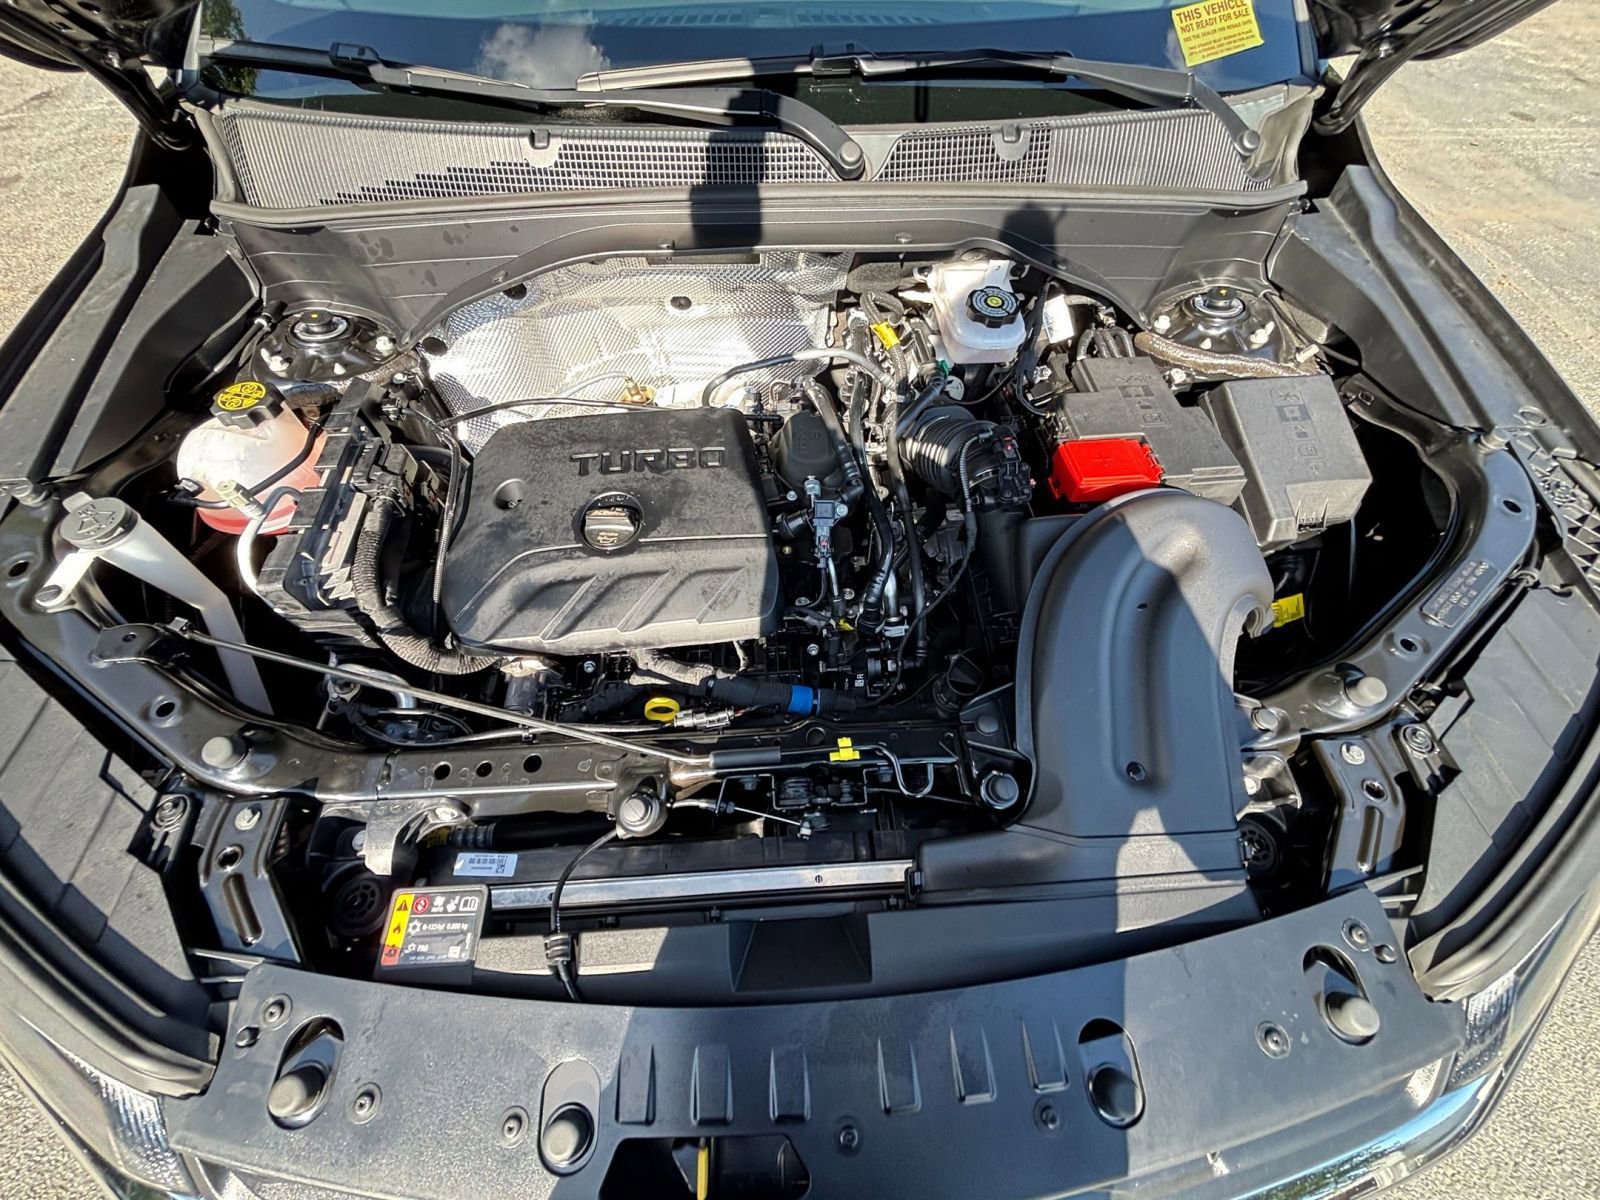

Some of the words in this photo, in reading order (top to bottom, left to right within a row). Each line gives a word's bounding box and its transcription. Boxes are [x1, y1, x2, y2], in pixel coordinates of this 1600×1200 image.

[1176, 8, 1202, 24] THIS
[1203, 0, 1248, 16] VEHICLE
[1180, 22, 1195, 34] NOT
[1196, 17, 1218, 30] READY
[1218, 12, 1233, 23] FOR
[1233, 8, 1250, 19] SALE
[570, 447, 727, 477] TURBO
